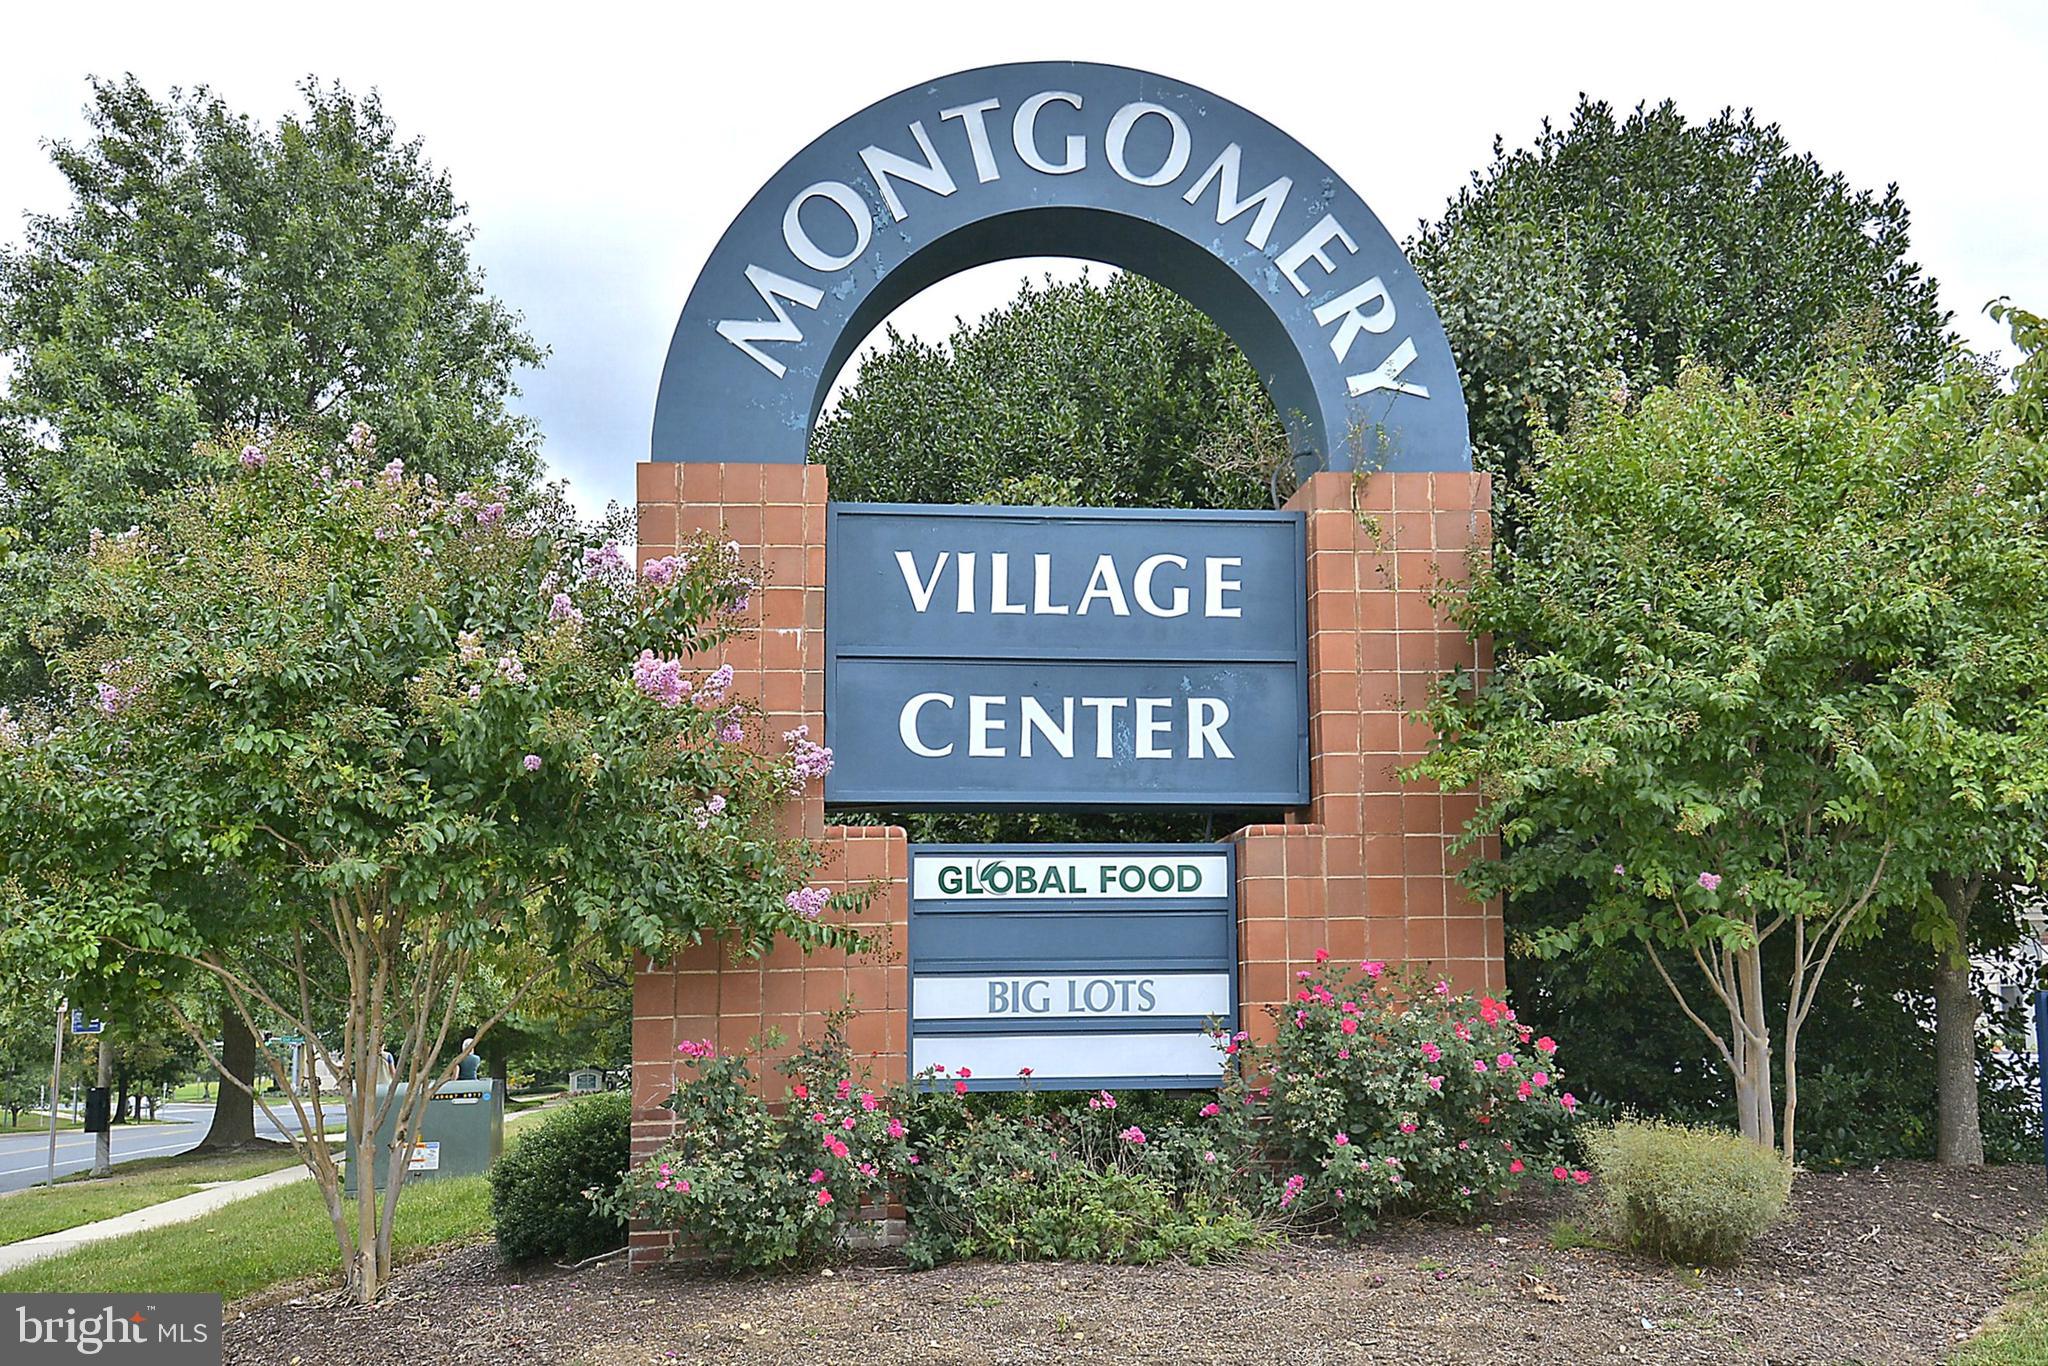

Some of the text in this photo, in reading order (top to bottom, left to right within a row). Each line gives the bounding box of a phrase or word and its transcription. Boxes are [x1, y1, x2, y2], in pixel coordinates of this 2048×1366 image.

[715, 90, 1430, 399] MONTGOMERY
[894, 550, 1243, 618] VILLAGE
[899, 692, 1235, 760] CENTER
[938, 860, 1202, 895] GLOBAL FOOD
[988, 979, 1156, 1014] BIG LOTS
